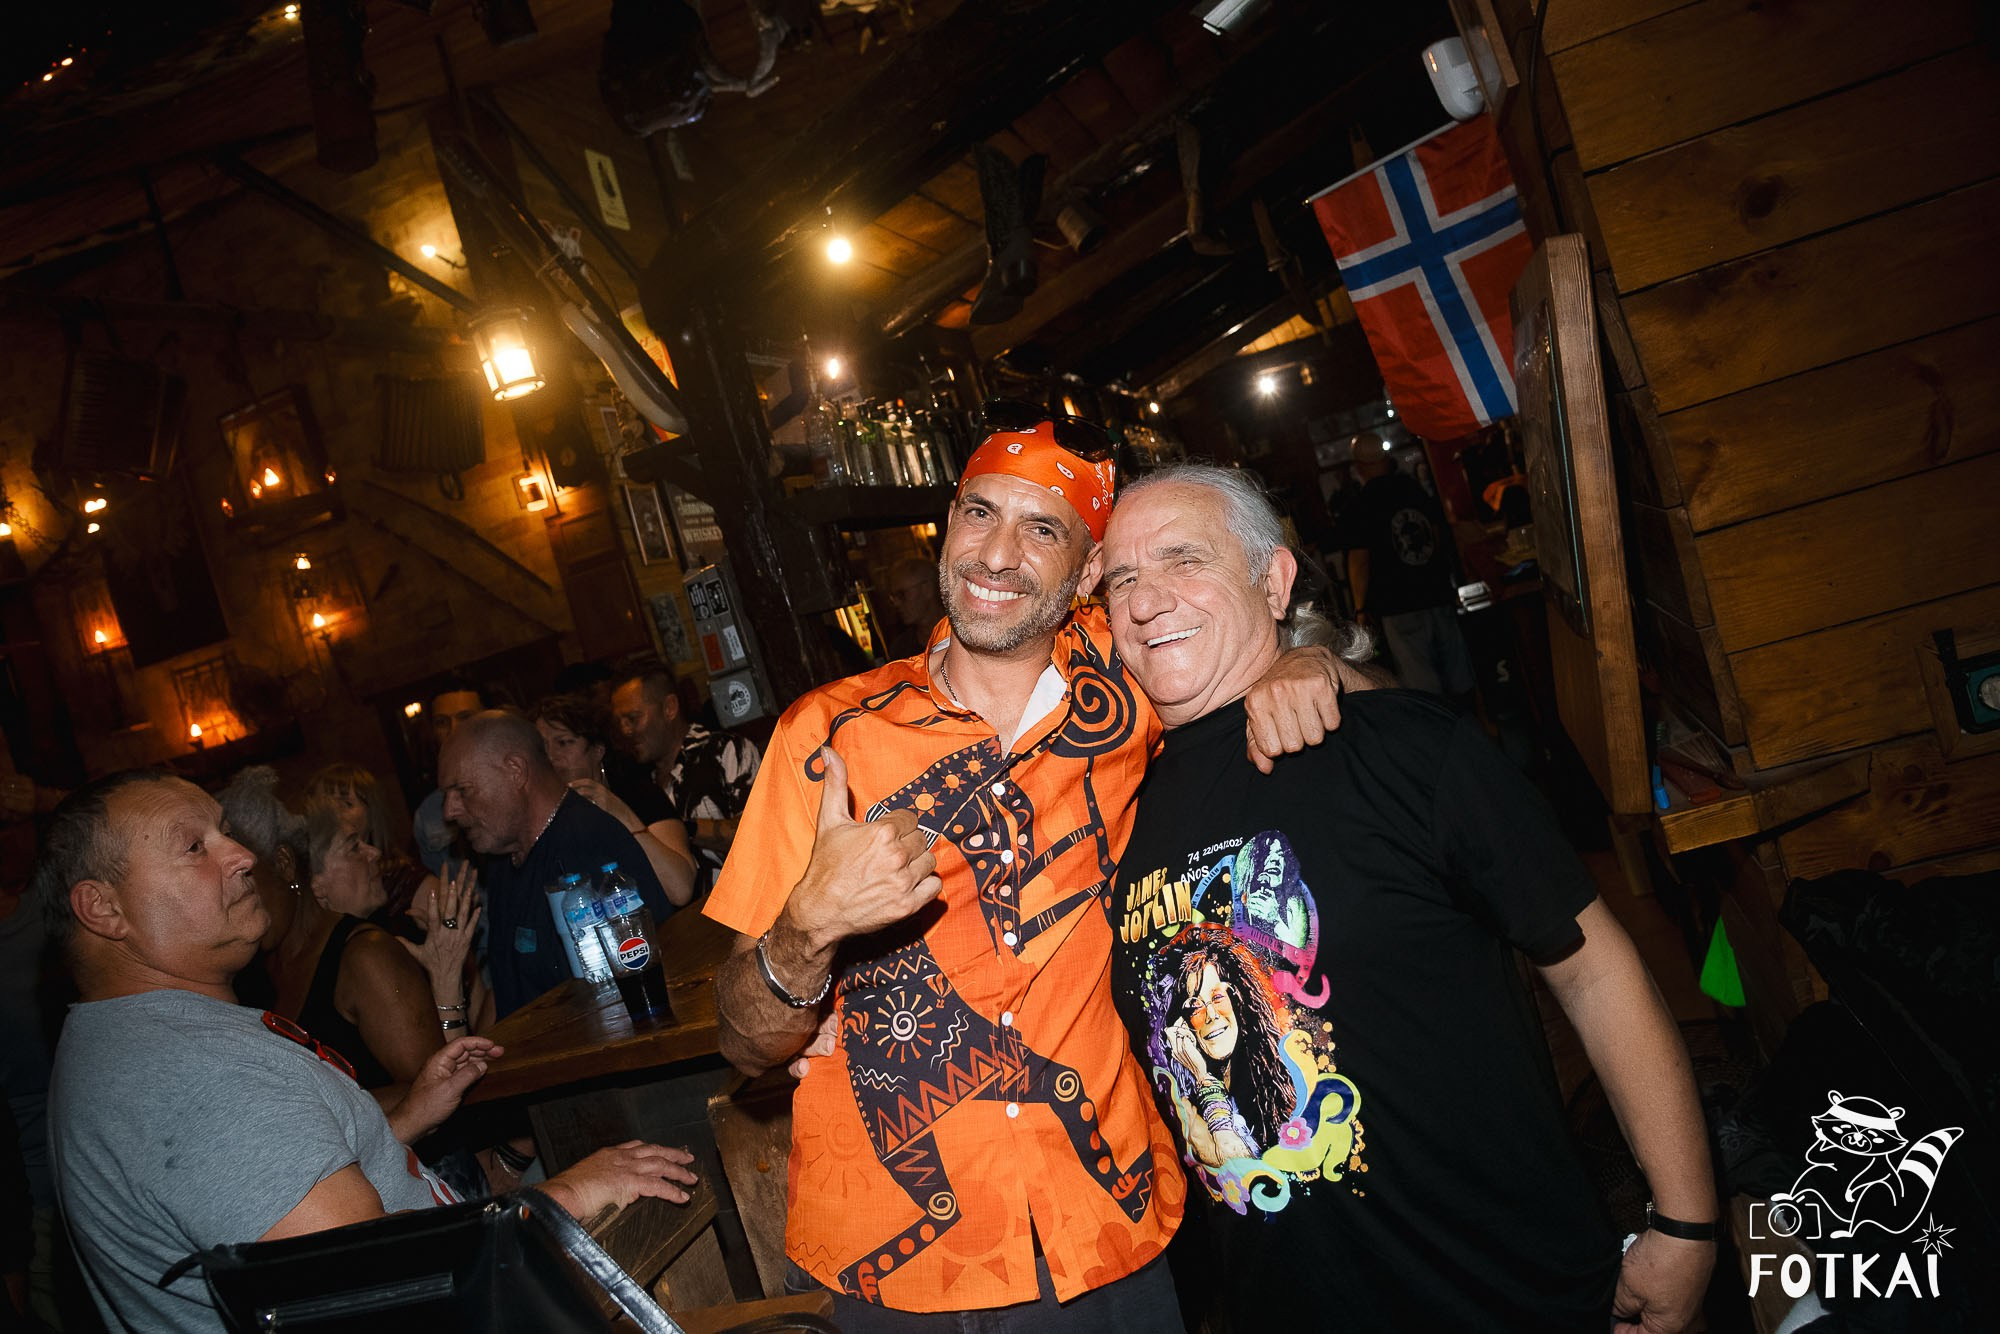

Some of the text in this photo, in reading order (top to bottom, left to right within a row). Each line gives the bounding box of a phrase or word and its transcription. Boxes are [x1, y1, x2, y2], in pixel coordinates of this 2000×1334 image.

[1187, 851, 1200, 864] 74
[1180, 866, 1210, 883] AÑOS
[620, 946, 648, 960] PEPSI
